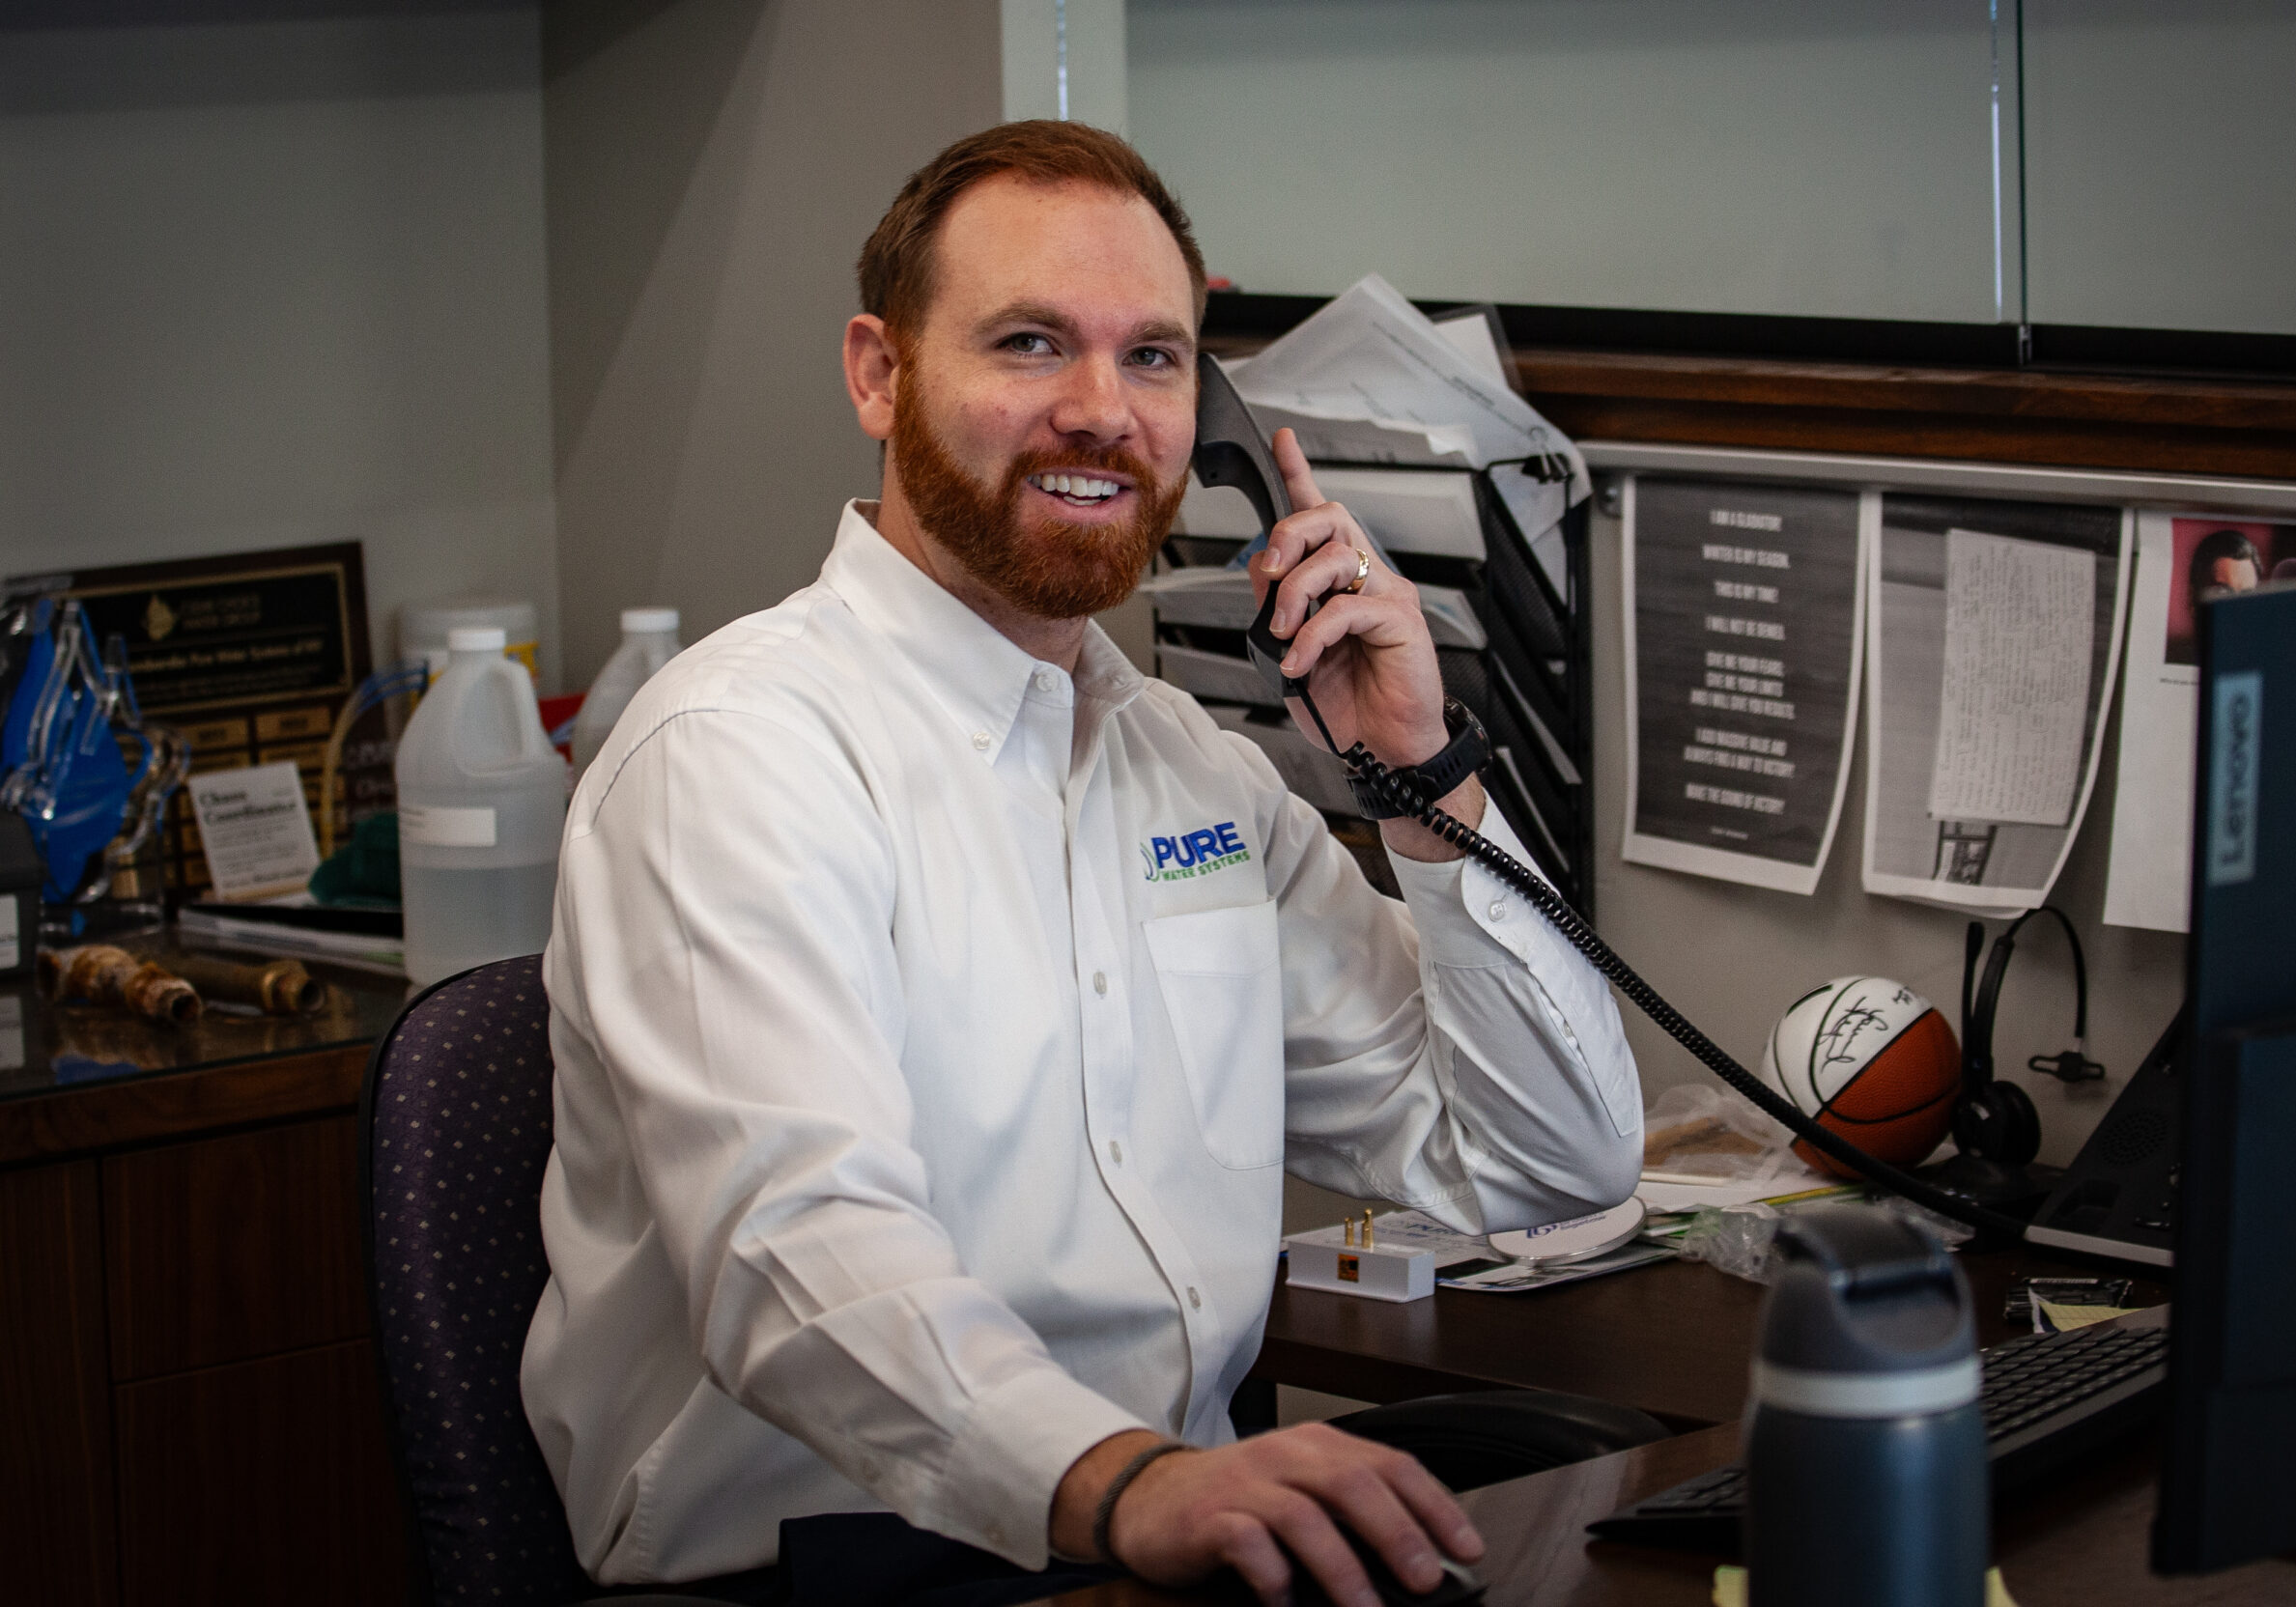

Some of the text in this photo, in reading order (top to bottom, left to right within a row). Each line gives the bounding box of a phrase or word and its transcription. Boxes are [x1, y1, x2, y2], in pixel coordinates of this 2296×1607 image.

[2221, 691, 2253, 865] Lenovo
[1151, 822, 1246, 868] PURE
[1162, 850, 1251, 881] WATER SYSTEMS
